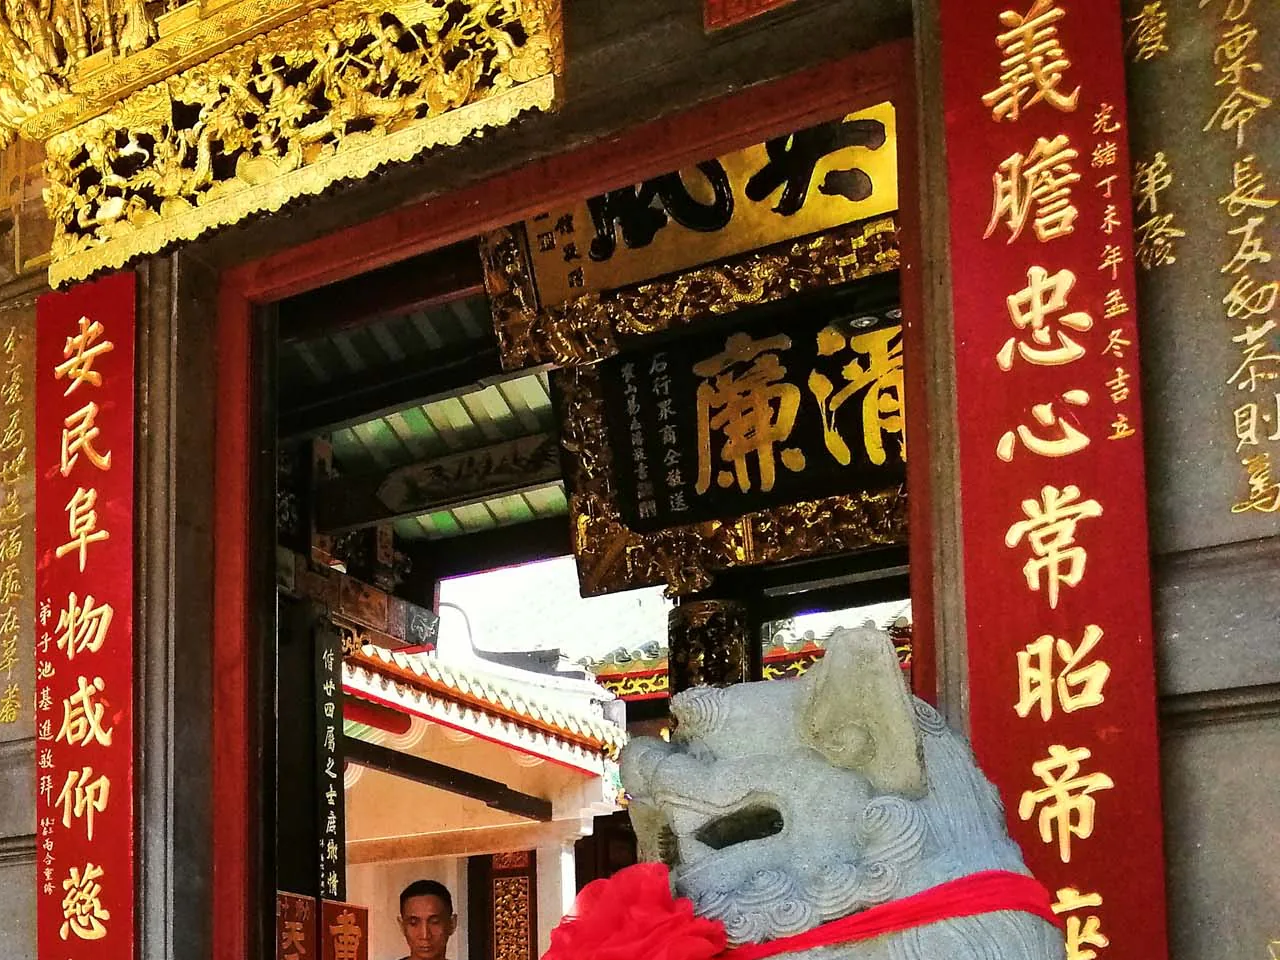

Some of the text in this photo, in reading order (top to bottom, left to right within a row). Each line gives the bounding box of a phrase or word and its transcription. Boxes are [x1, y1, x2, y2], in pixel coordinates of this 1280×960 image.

[1090, 103, 1136, 441] 光緒丁未年孟冬吉立
